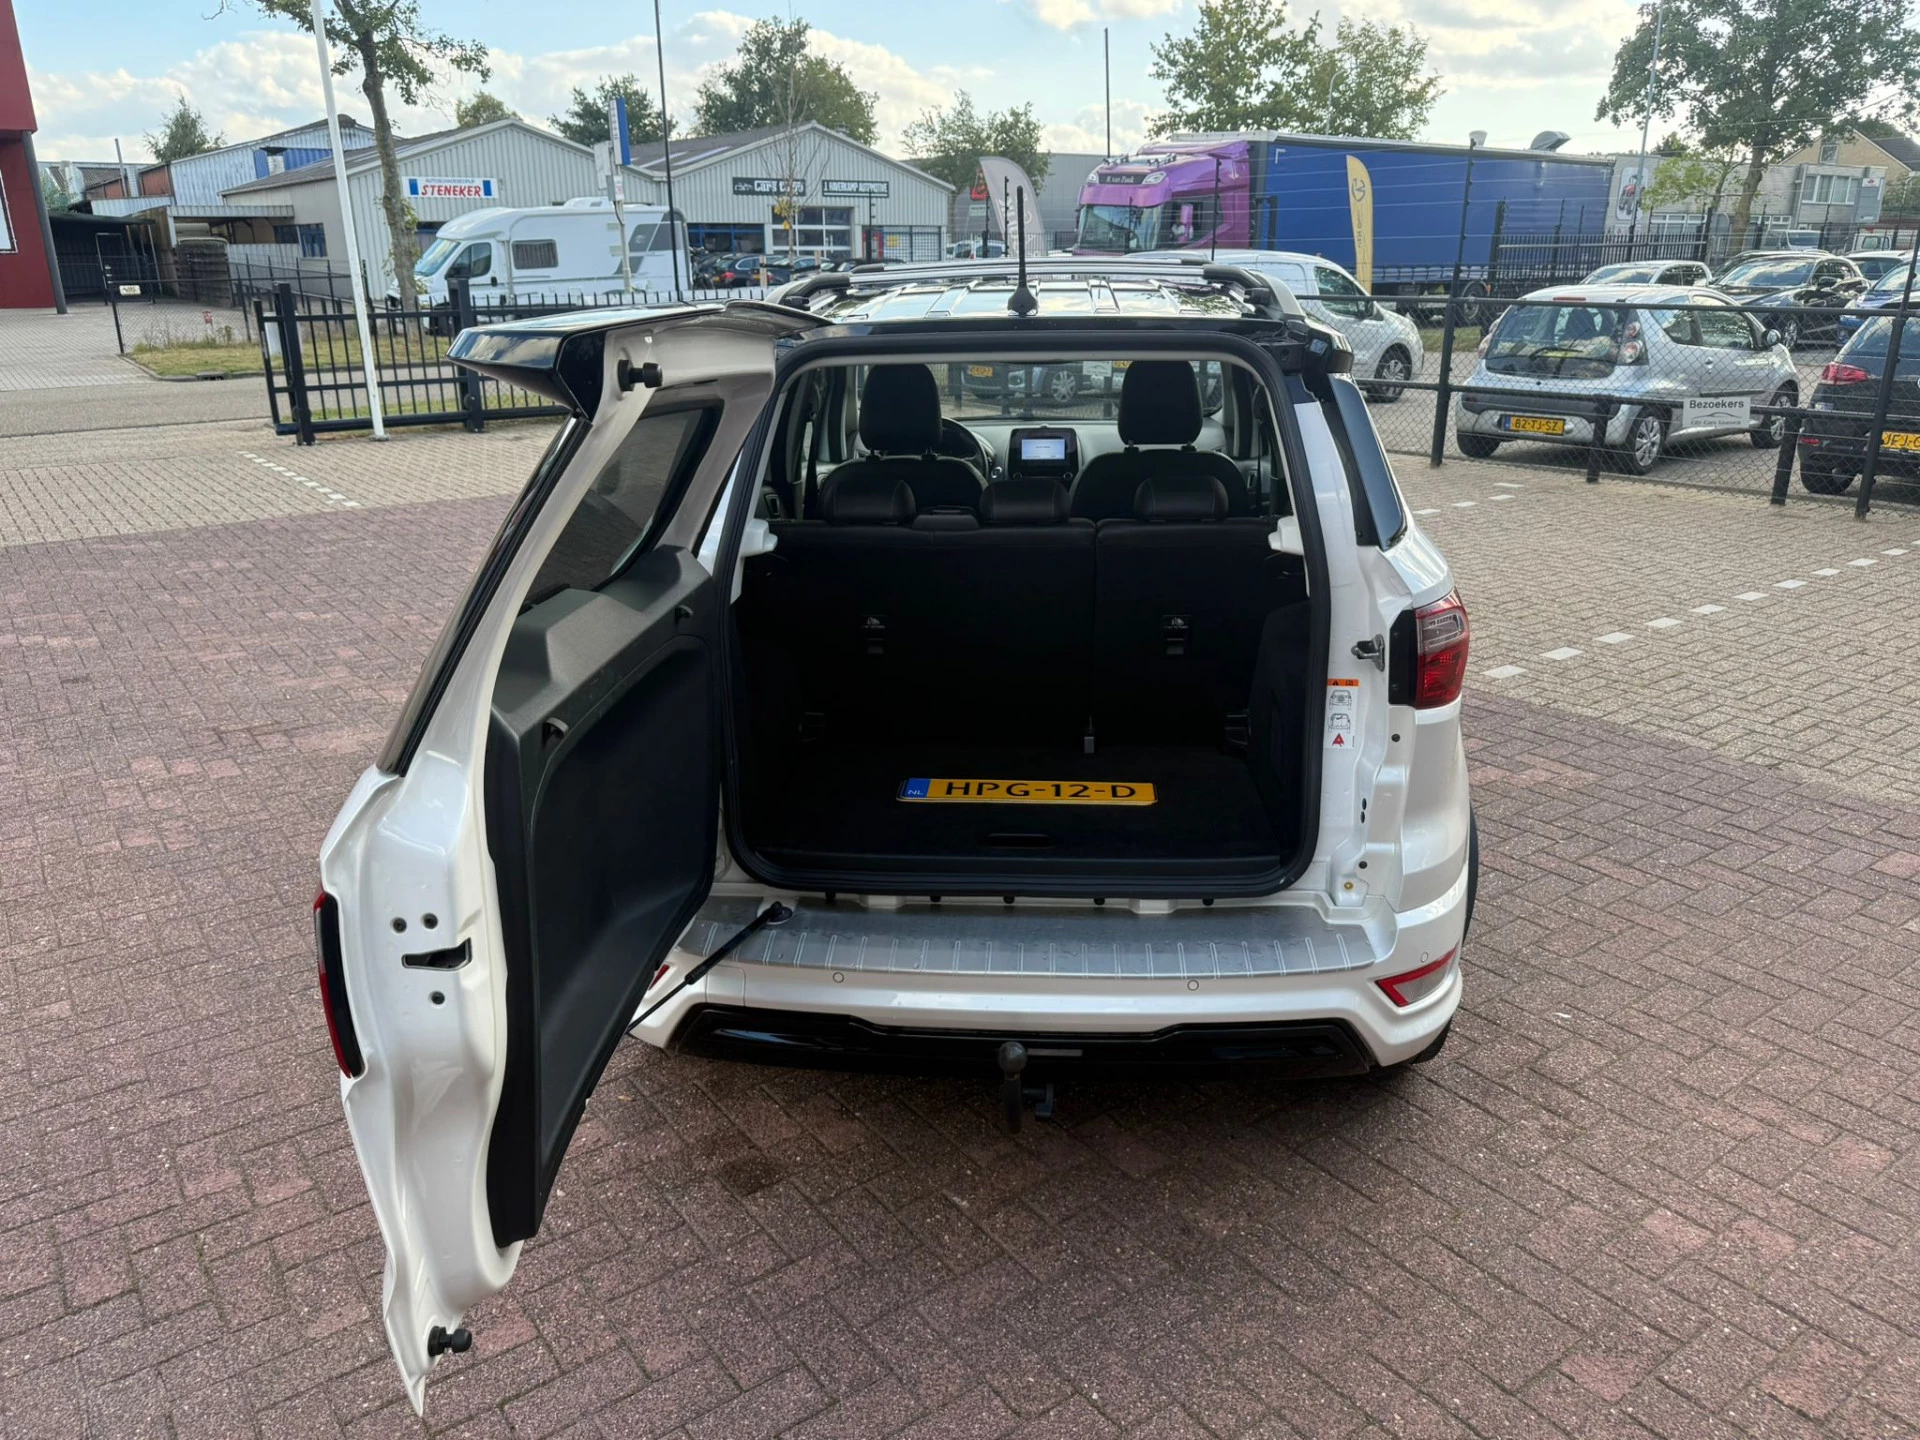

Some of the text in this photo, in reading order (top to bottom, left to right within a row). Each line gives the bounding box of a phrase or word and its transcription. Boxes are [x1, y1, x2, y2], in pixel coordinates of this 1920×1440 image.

[422, 185, 481, 198] STENEKER
[754, 180, 777, 192] Cars
[1689, 399, 1745, 409] Bezoekers
[945, 782, 1136, 798] HPG-12-D
